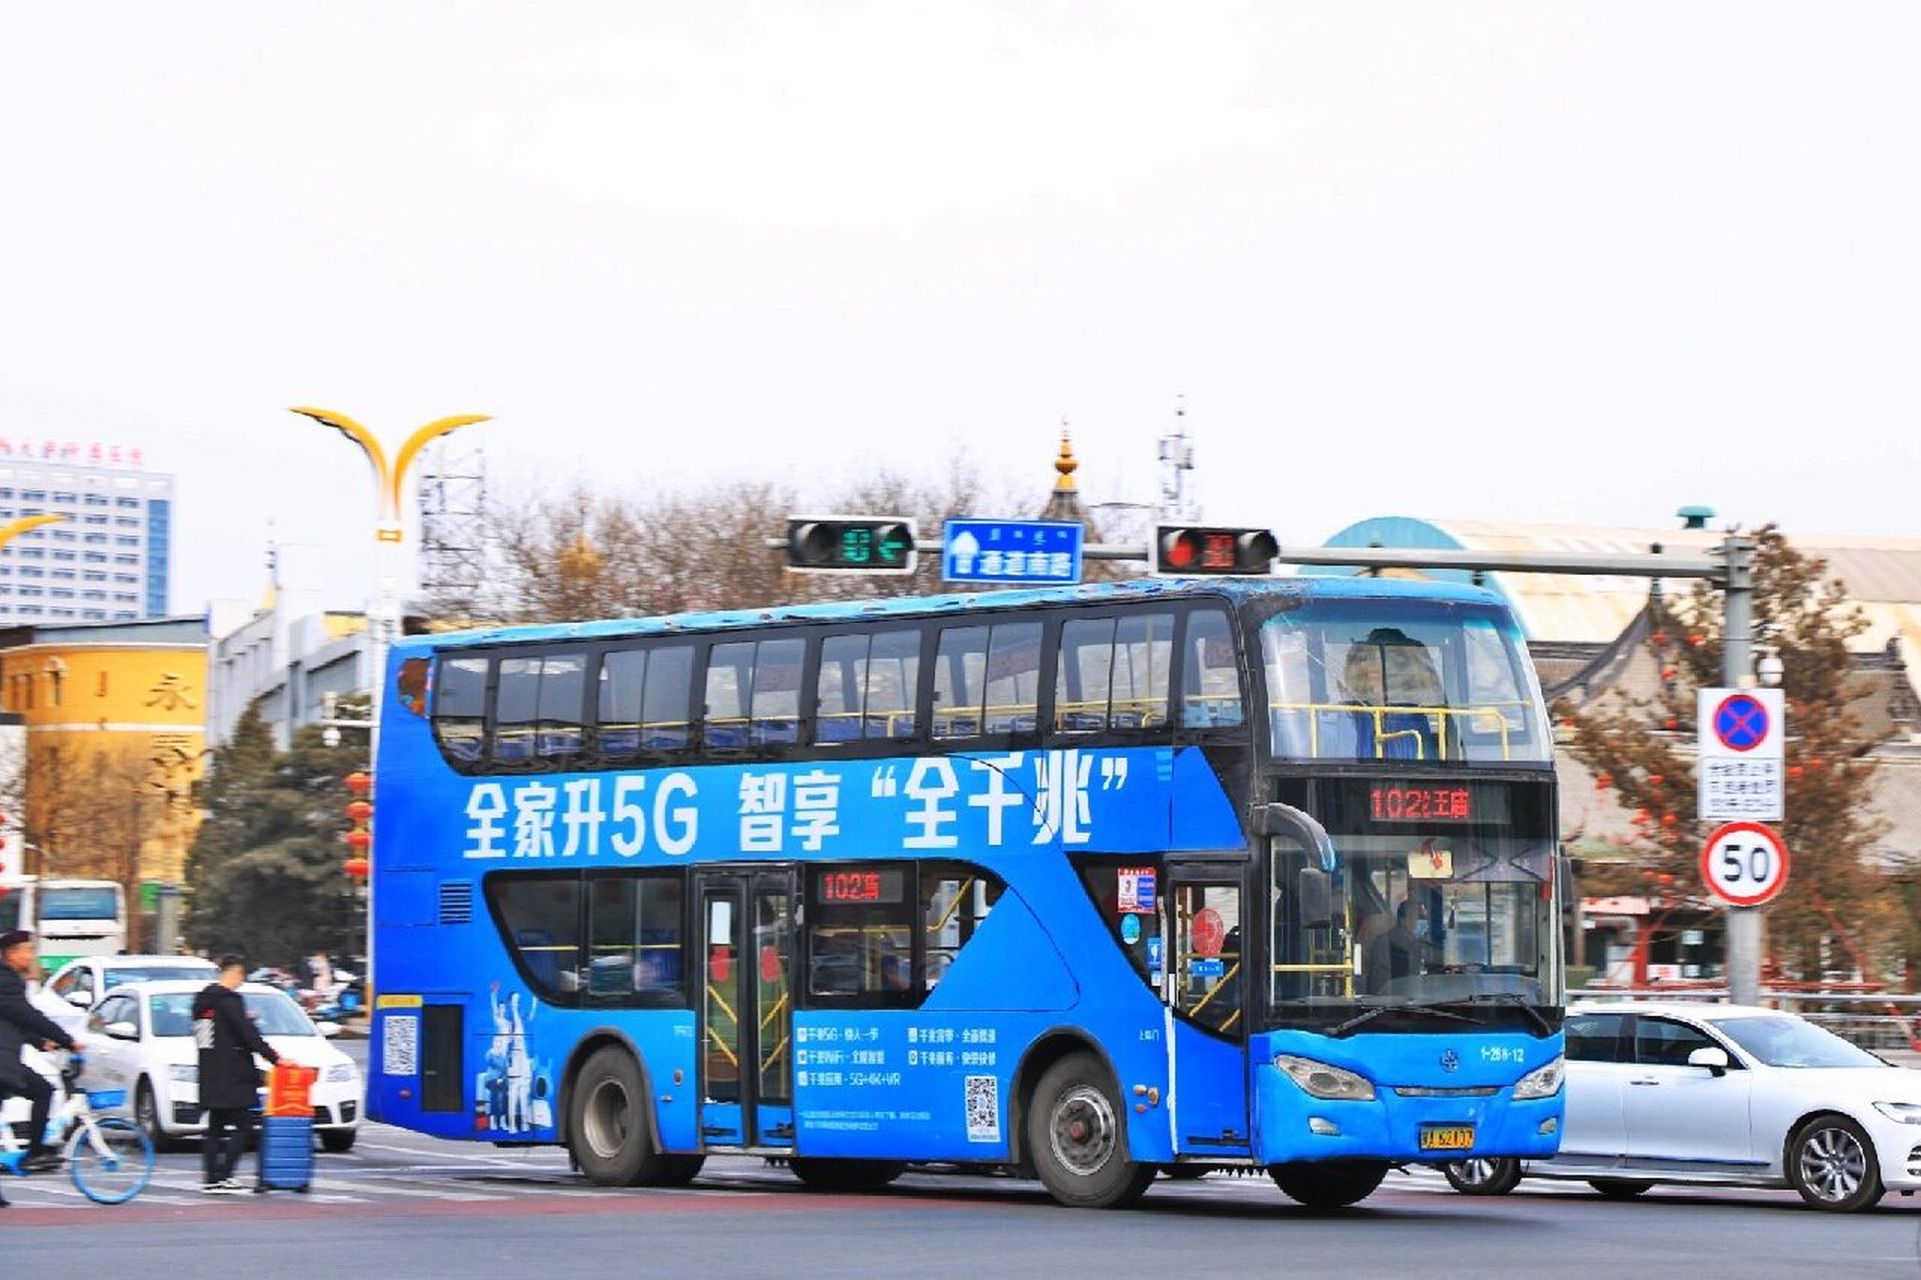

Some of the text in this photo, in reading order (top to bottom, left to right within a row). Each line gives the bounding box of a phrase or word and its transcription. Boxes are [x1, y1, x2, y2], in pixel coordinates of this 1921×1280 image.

[464, 772, 699, 859] 全家升5G
[737, 770, 842, 852] 智享
[1723, 844, 1770, 883] 50
